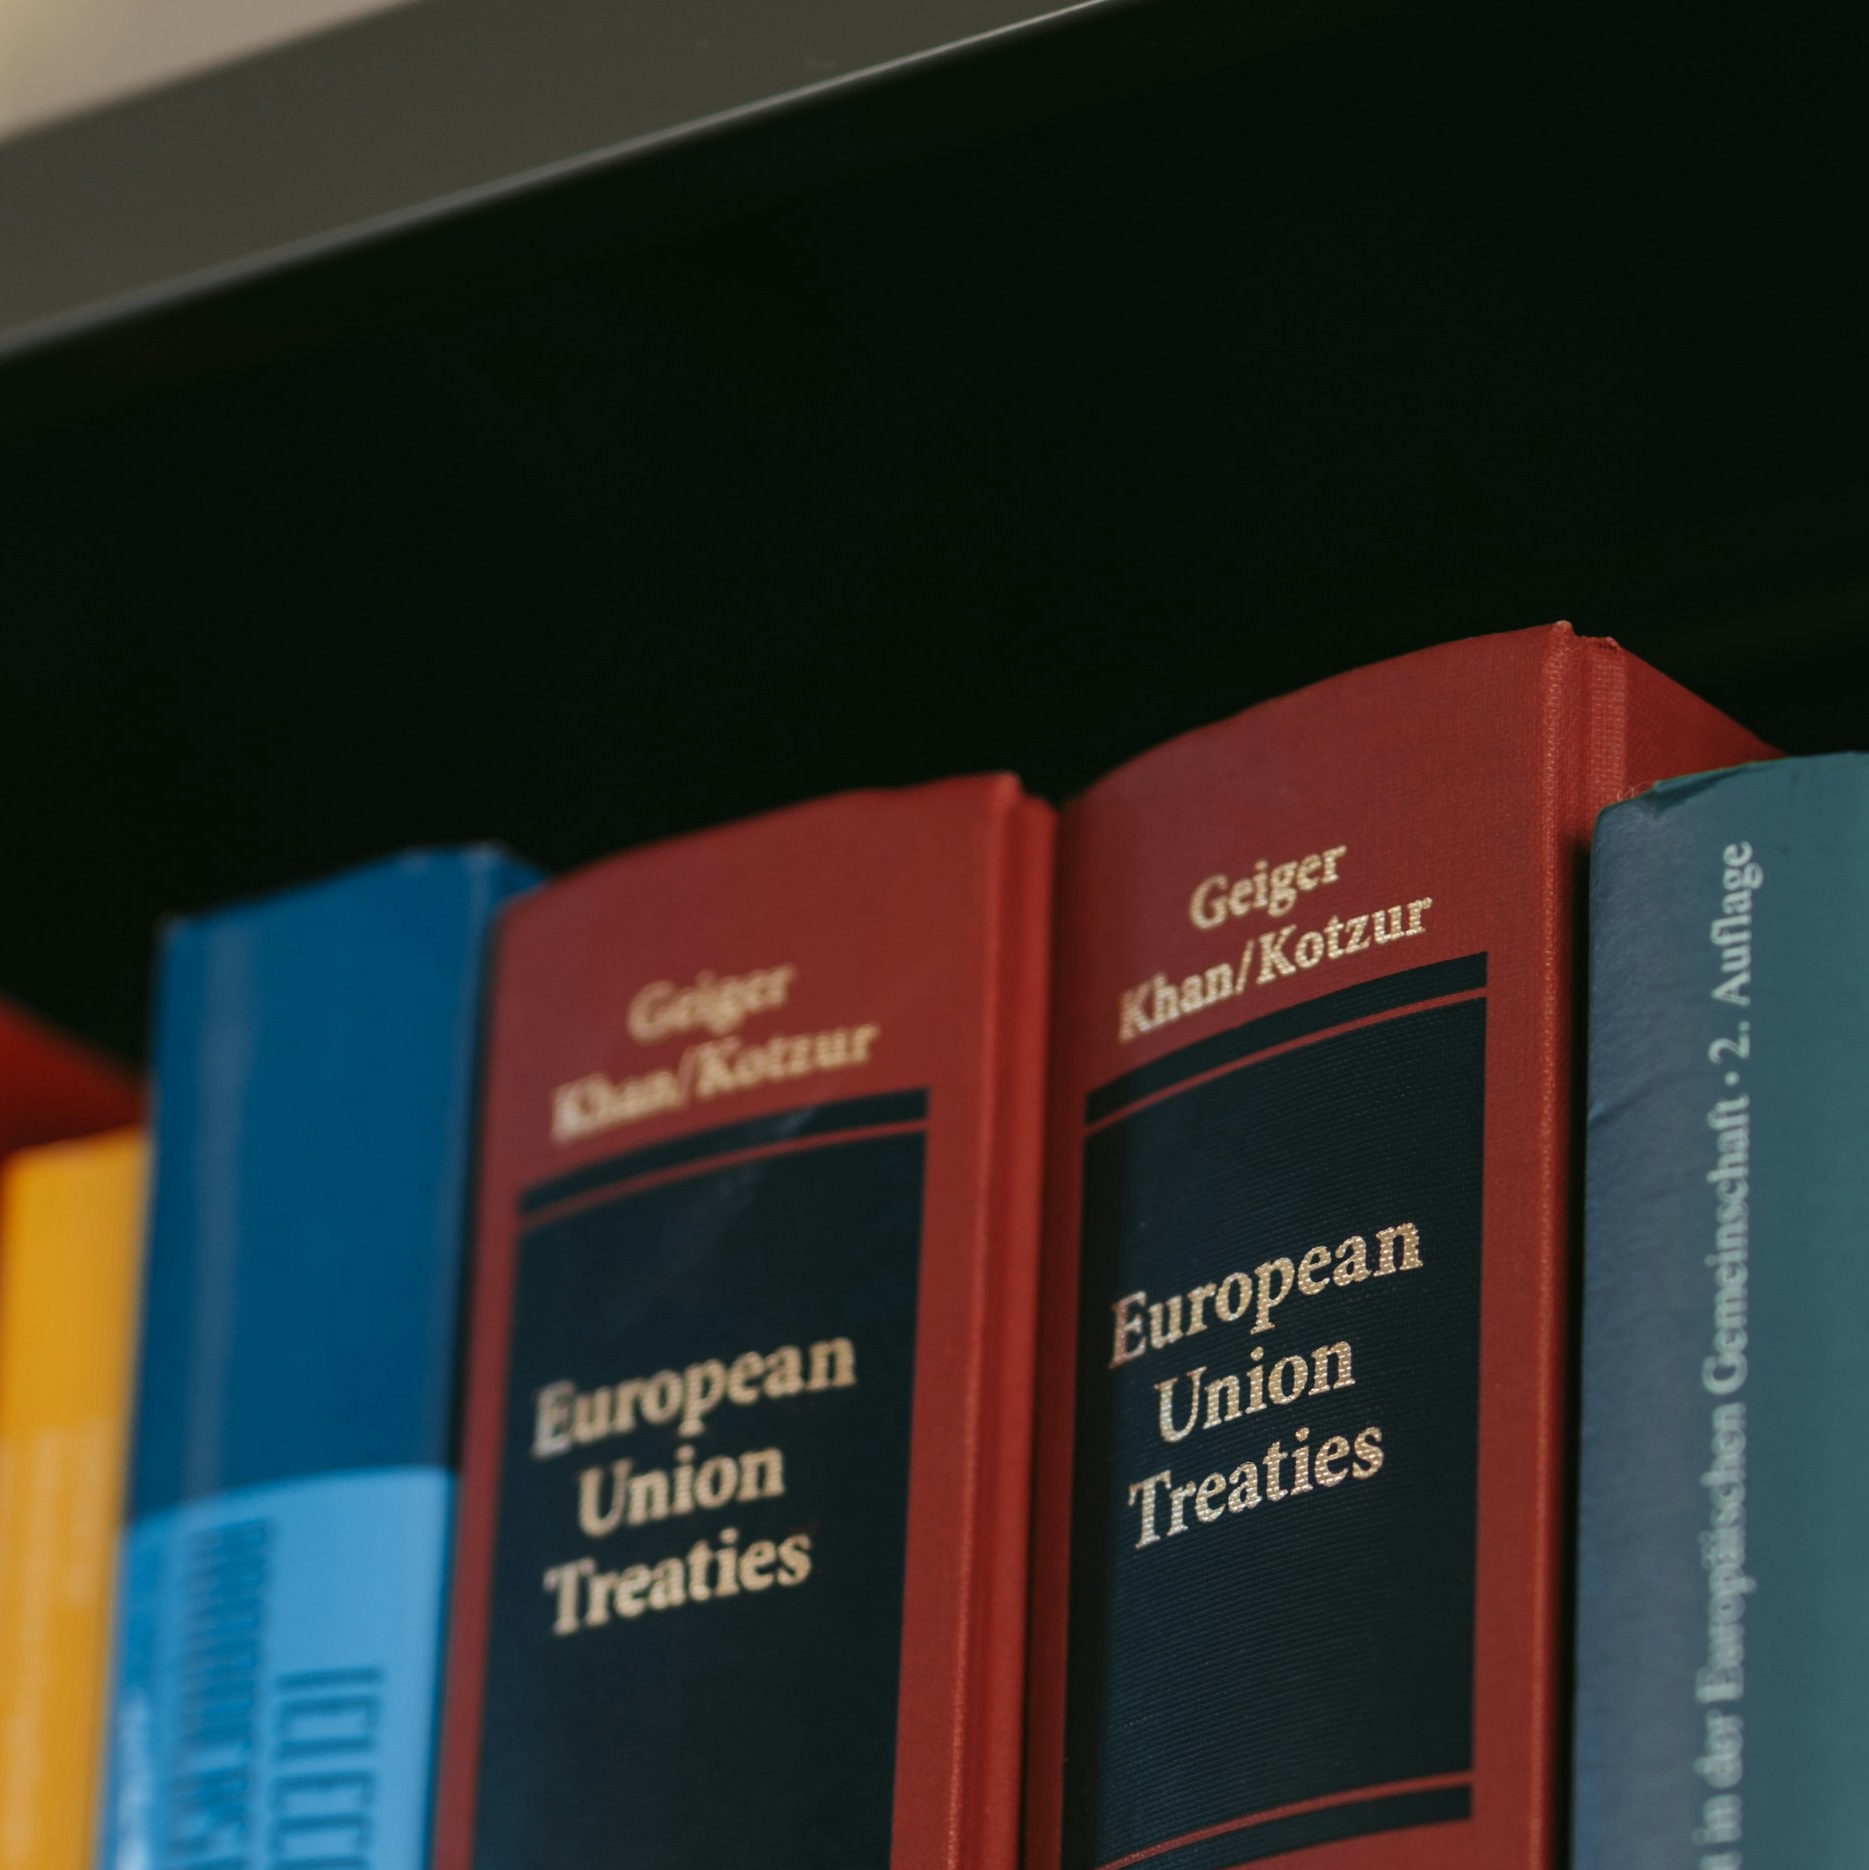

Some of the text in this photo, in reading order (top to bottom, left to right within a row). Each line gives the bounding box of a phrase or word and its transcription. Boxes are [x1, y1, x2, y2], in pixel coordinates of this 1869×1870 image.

[1188, 844, 1347, 930] Geiger
[1710, 841, 1764, 1006] Auflage
[627, 963, 797, 1045] Geiger
[1118, 896, 1433, 1044] Khan/Kotzur
[551, 1022, 880, 1148] Khan/Kotzur
[1708, 1020, 1751, 1063] 2.
[1109, 1221, 1424, 1370] European
[1702, 1095, 1750, 1395] Gemeinschaft
[532, 1336, 858, 1459] European
[1153, 1340, 1356, 1444] Union
[577, 1444, 787, 1538] Union
[1127, 1425, 1386, 1550] Treaties
[543, 1527, 814, 1636] Treaties
